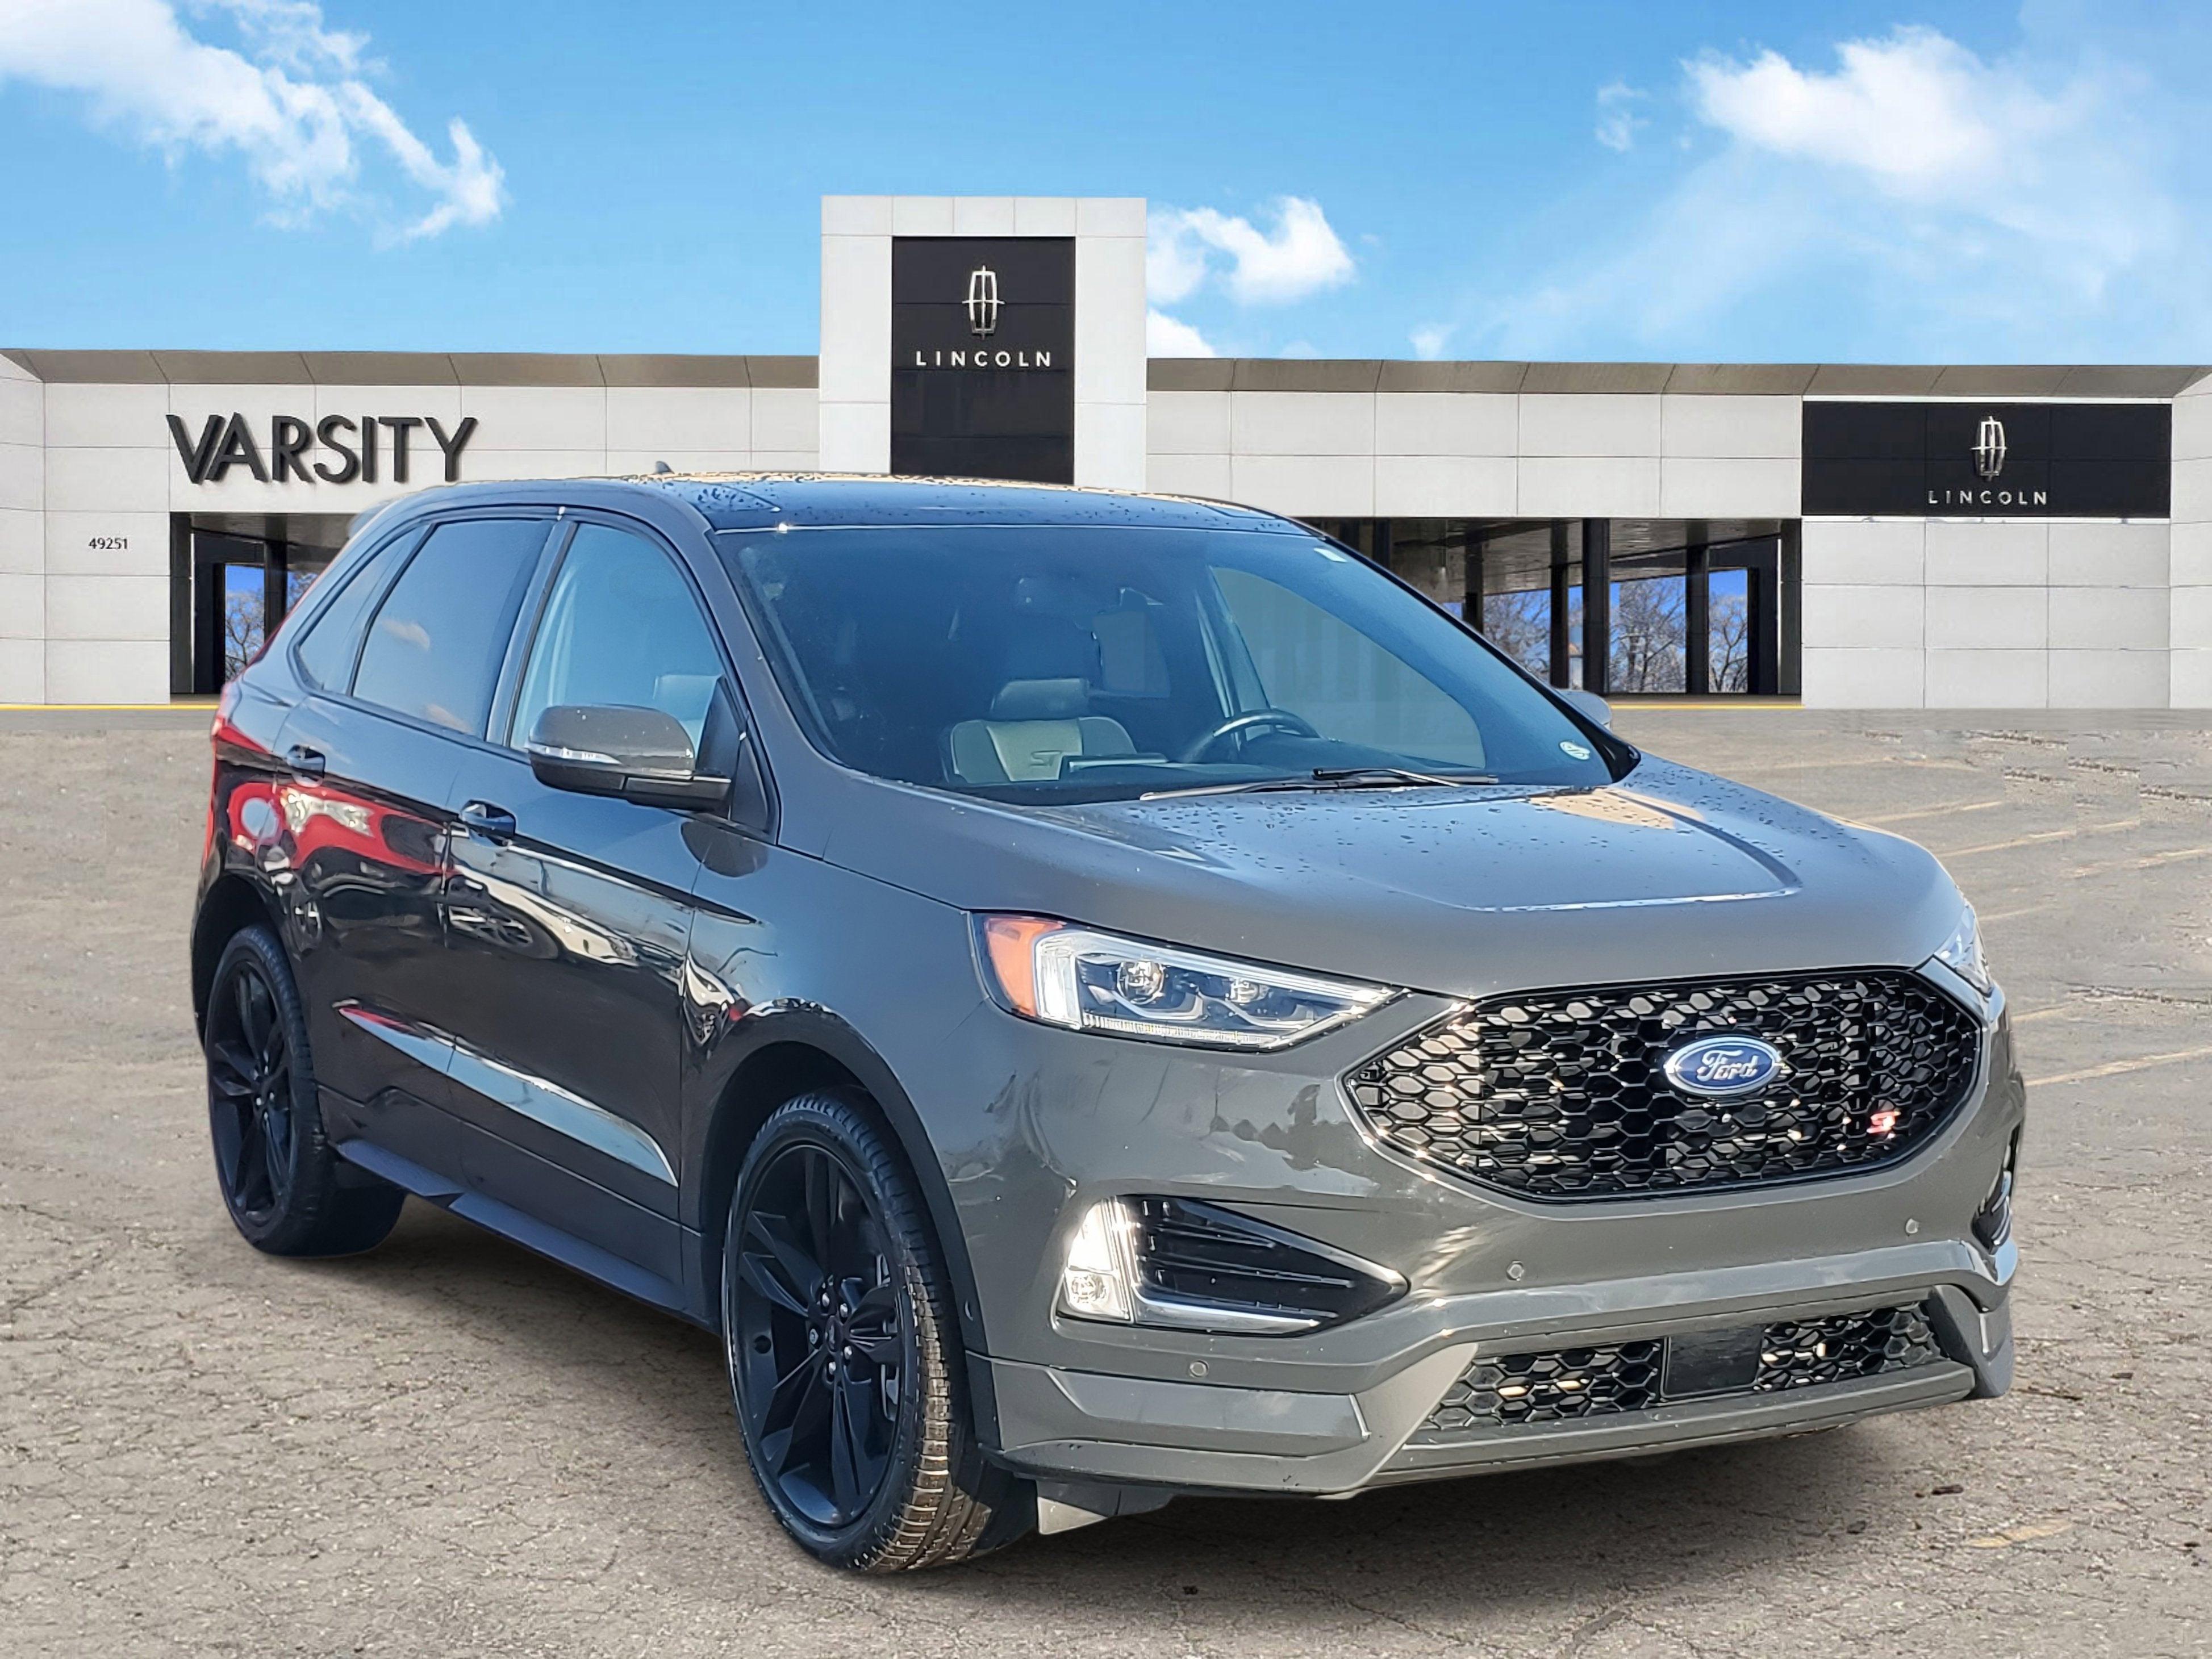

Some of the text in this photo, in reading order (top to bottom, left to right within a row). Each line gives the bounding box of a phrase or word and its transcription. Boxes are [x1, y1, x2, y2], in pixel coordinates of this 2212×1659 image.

[916, 350, 1050, 367] LINCOLN
[166, 412, 478, 484] VARSITY
[1928, 490, 2047, 505] LINCOLN
[88, 537, 127, 549] 49251
[1696, 1050, 1759, 1081] Ford
